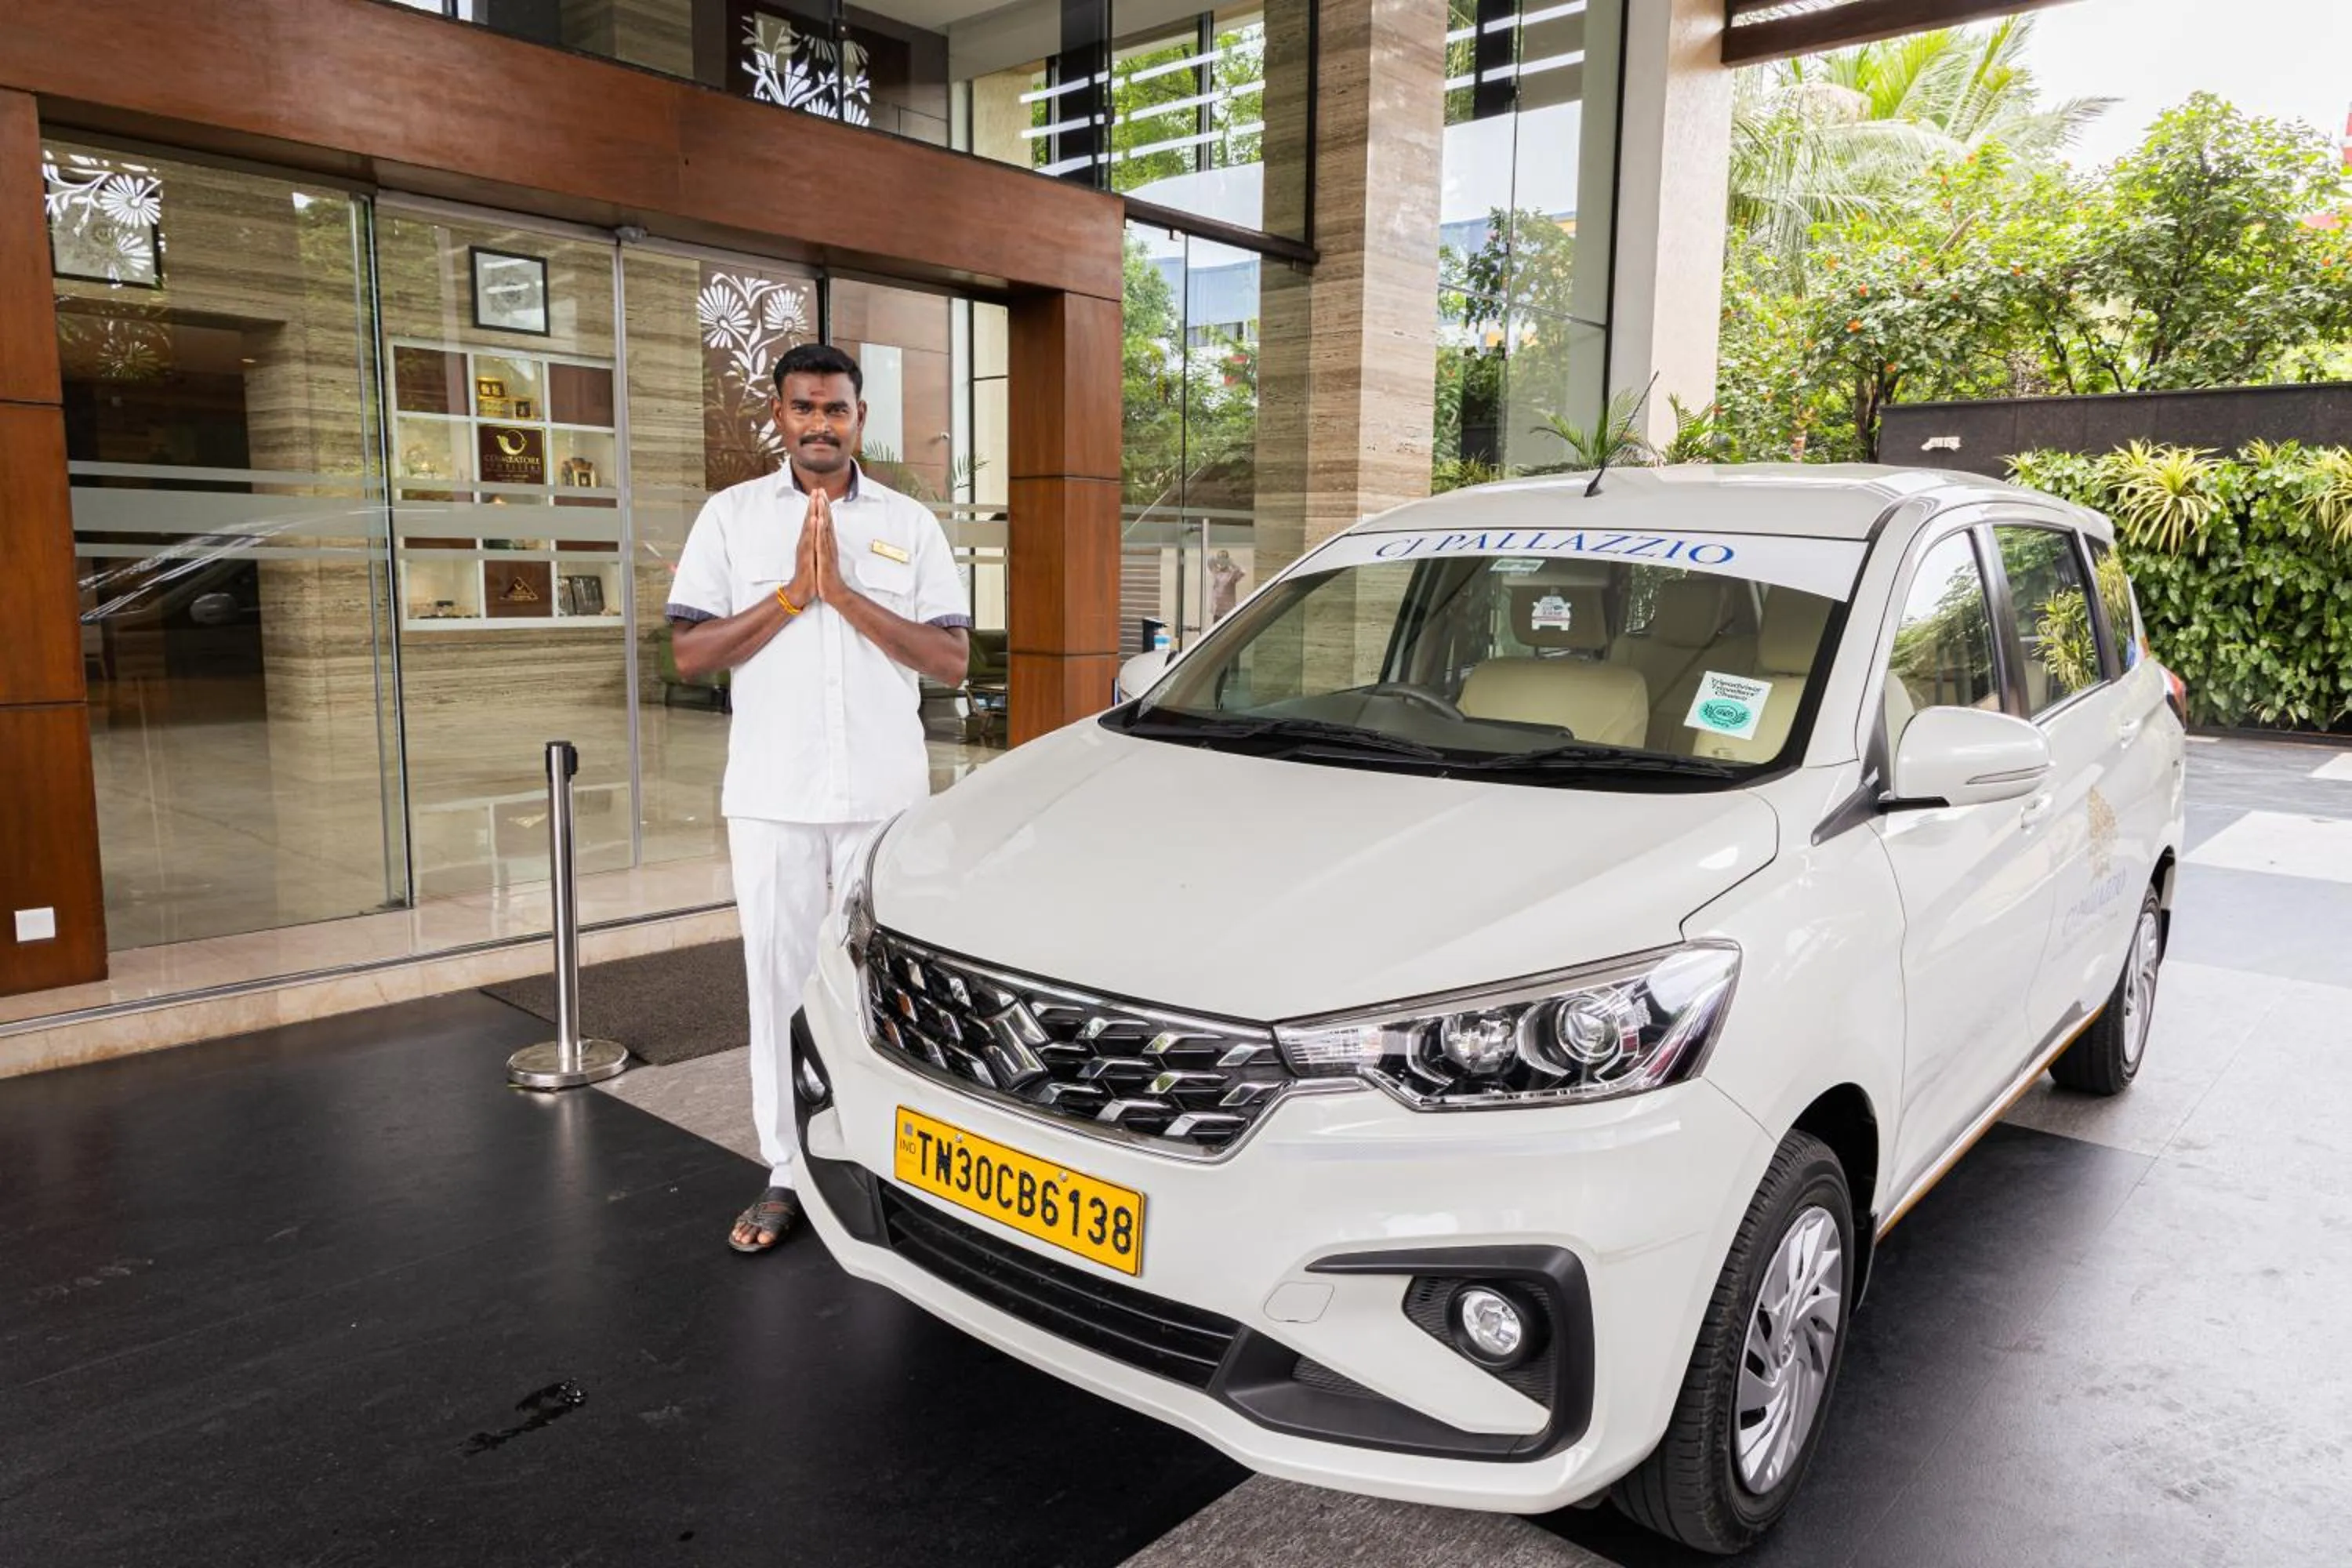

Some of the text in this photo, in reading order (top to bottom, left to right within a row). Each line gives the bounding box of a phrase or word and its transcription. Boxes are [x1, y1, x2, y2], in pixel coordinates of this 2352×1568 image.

[1376, 532, 1734, 564] CJ PALLAZZIO
[899, 1138, 916, 1155] IND
[917, 1129, 1133, 1255] TN30CB6138
